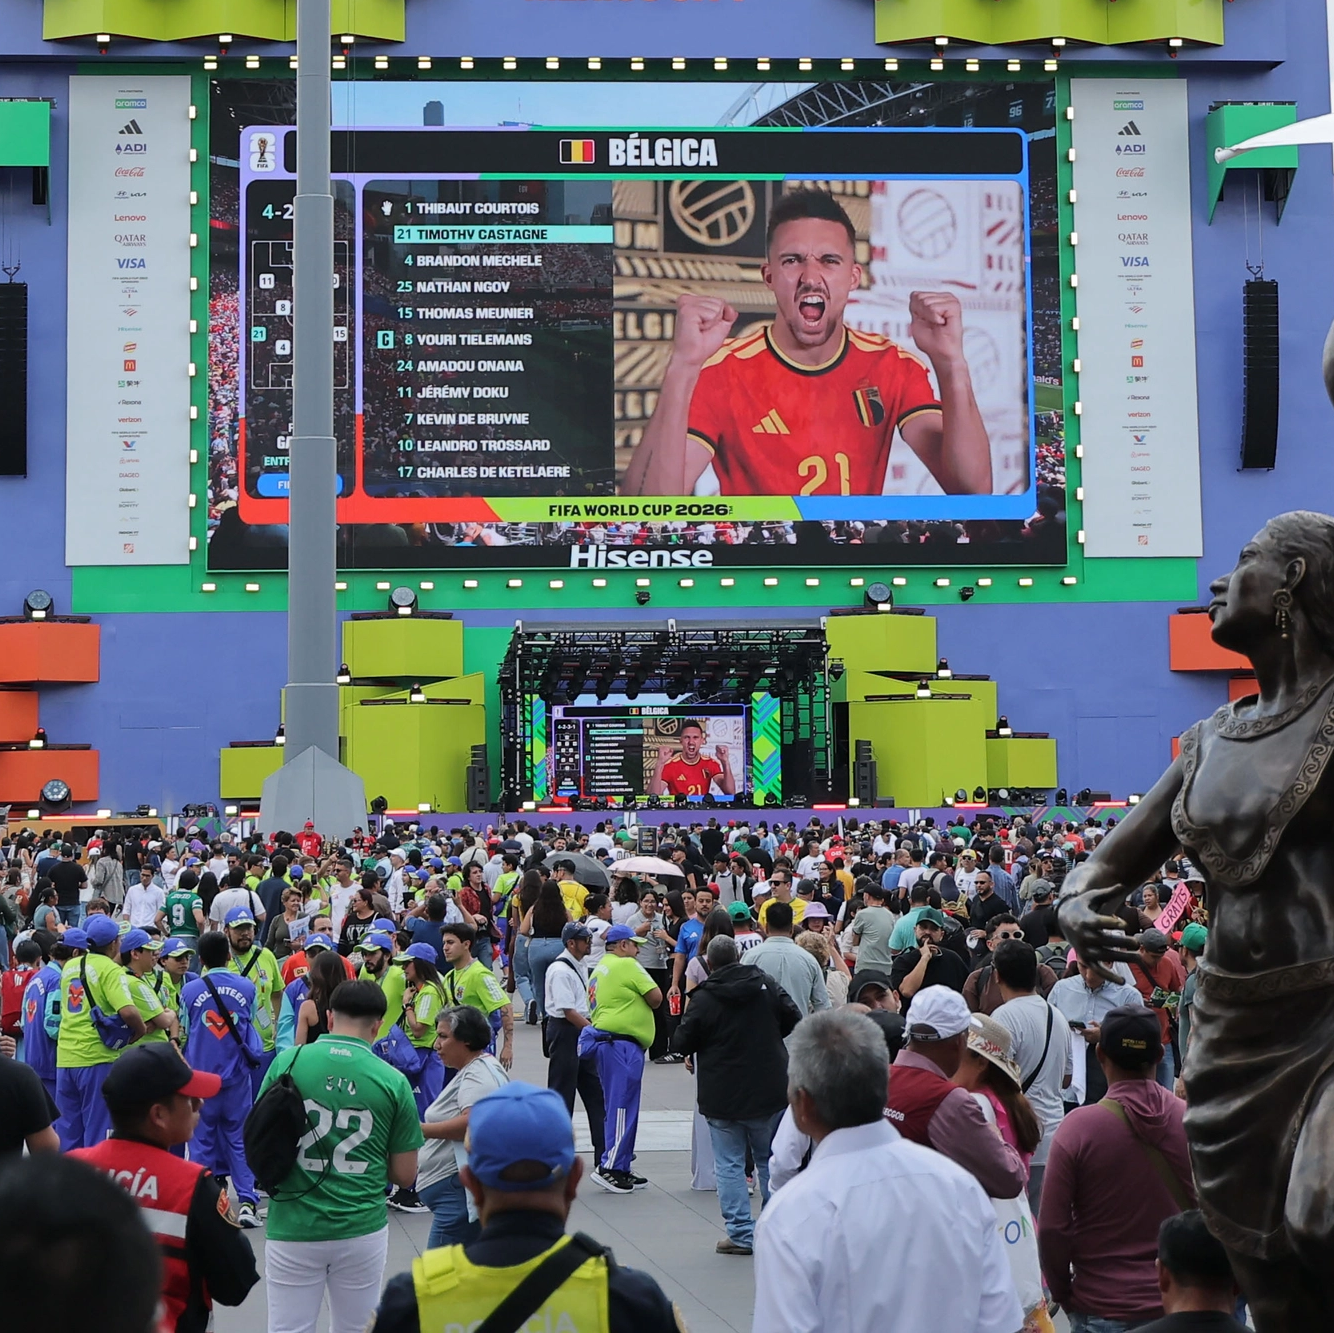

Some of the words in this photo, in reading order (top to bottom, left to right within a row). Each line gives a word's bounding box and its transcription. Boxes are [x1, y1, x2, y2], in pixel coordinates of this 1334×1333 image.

[608, 132, 718, 166] BÉLGICA
[405, 203, 412, 213] 1
[417, 202, 472, 214] THIBAUT
[474, 202, 539, 214] COURTOIS
[397, 229, 412, 240] 21
[478, 228, 548, 240] CASTAGNE
[404, 255, 413, 266] 4
[417, 255, 480, 267] BRANDON
[482, 255, 542, 267] MECHELE
[261, 277, 272, 285] 11
[397, 282, 413, 292] 25
[417, 281, 471, 293] NATHAN
[280, 304, 286, 312] 8
[397, 308, 413, 319] 15
[417, 308, 473, 319] THOMAS
[476, 308, 534, 319] MEUNIER
[253, 330, 264, 339] 21
[335, 330, 346, 339] 15
[381, 333, 390, 346] C
[404, 334, 413, 345] 8
[459, 334, 532, 345] TIELEMANS
[396, 360, 413, 372] 24
[417, 361, 475, 372] AMADOU
[478, 361, 524, 372] ONANA
[397, 387, 412, 398] 11
[473, 387, 509, 398] DOKU
[405, 413, 413, 424] 7
[417, 413, 457, 425] KEVIN
[459, 413, 476, 425] DE
[397, 440, 413, 451] 10
[417, 440, 477, 451] LEANDRO
[480, 440, 550, 451] TROSSARD
[397, 466, 413, 478] 17
[417, 466, 477, 478] CHARLES
[479, 466, 498, 478] DE
[499, 466, 571, 478] KETELAERE
[798, 453, 850, 495] 21
[549, 505, 582, 516] FIFA
[584, 505, 639, 516] WORLD
[642, 505, 673, 516] CUP
[570, 545, 714, 567] Hisense
[1161, 888, 1187, 928] GRATIS
[172, 904, 185, 926] 9
[194, 985, 247, 1008] VOLNTEER
[296, 1098, 373, 1174] 22
[107, 1167, 158, 1200] ICÍA
